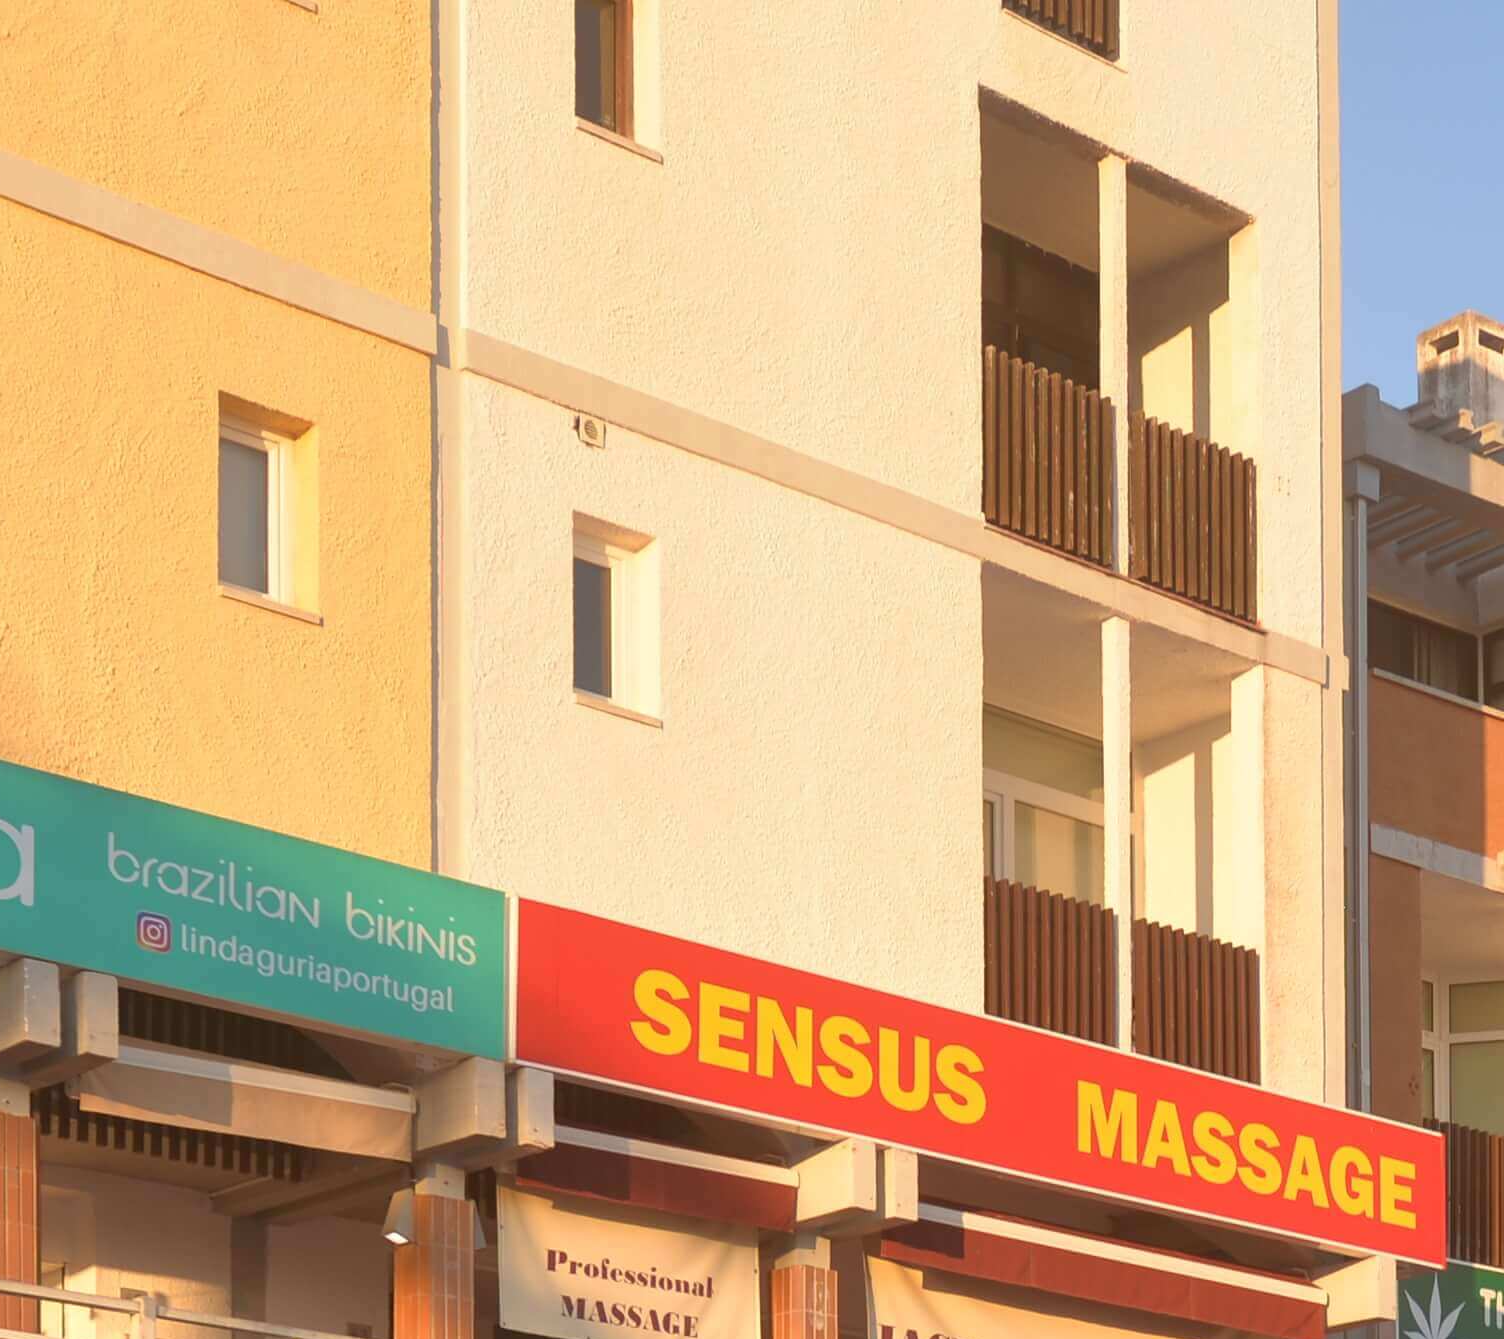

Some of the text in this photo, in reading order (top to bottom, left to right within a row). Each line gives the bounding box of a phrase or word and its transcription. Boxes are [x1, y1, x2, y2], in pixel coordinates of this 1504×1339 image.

[179, 923, 456, 1014] lindaguriaportugal
[630, 969, 1419, 1231] SENSUS MASSAGE
[545, 1247, 715, 1301] Professional
[559, 1293, 700, 1339] MASSAGE
